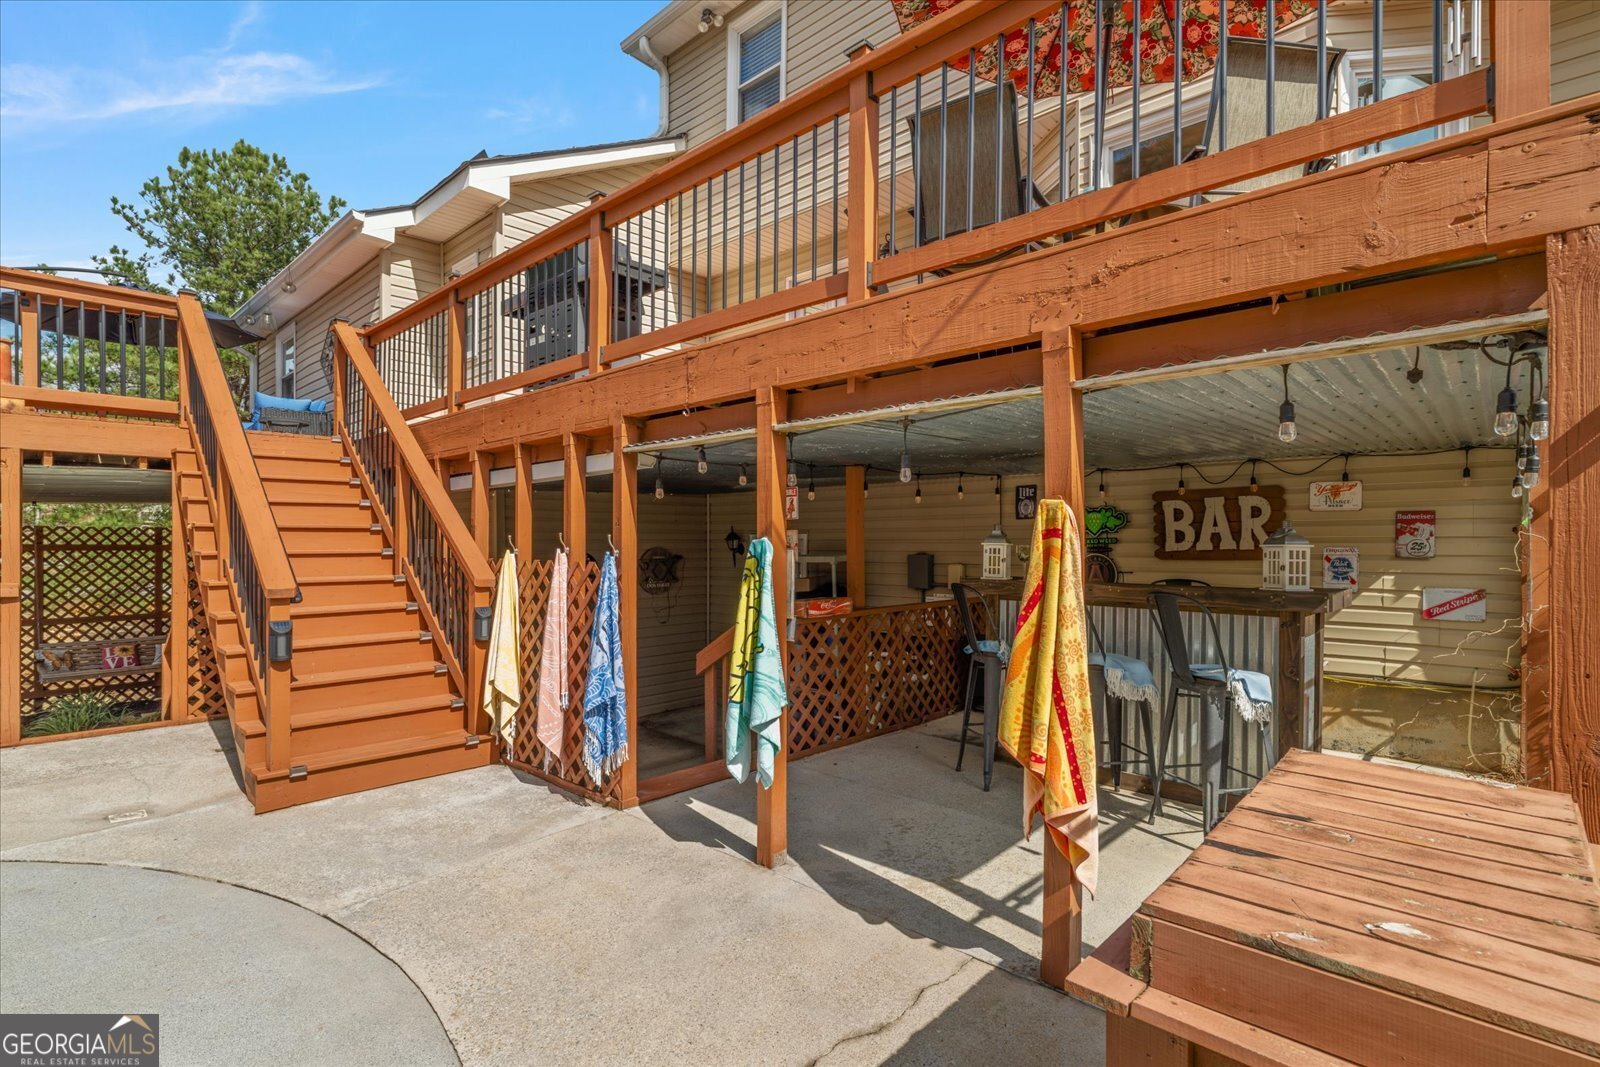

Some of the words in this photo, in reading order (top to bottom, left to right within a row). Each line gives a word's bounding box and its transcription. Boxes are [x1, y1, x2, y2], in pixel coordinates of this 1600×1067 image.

[1019, 487, 1035, 500] Lite
[1162, 496, 1272, 552] BAR
[1430, 602, 1450, 615] Red
[1450, 594, 1480, 609] Stripe
